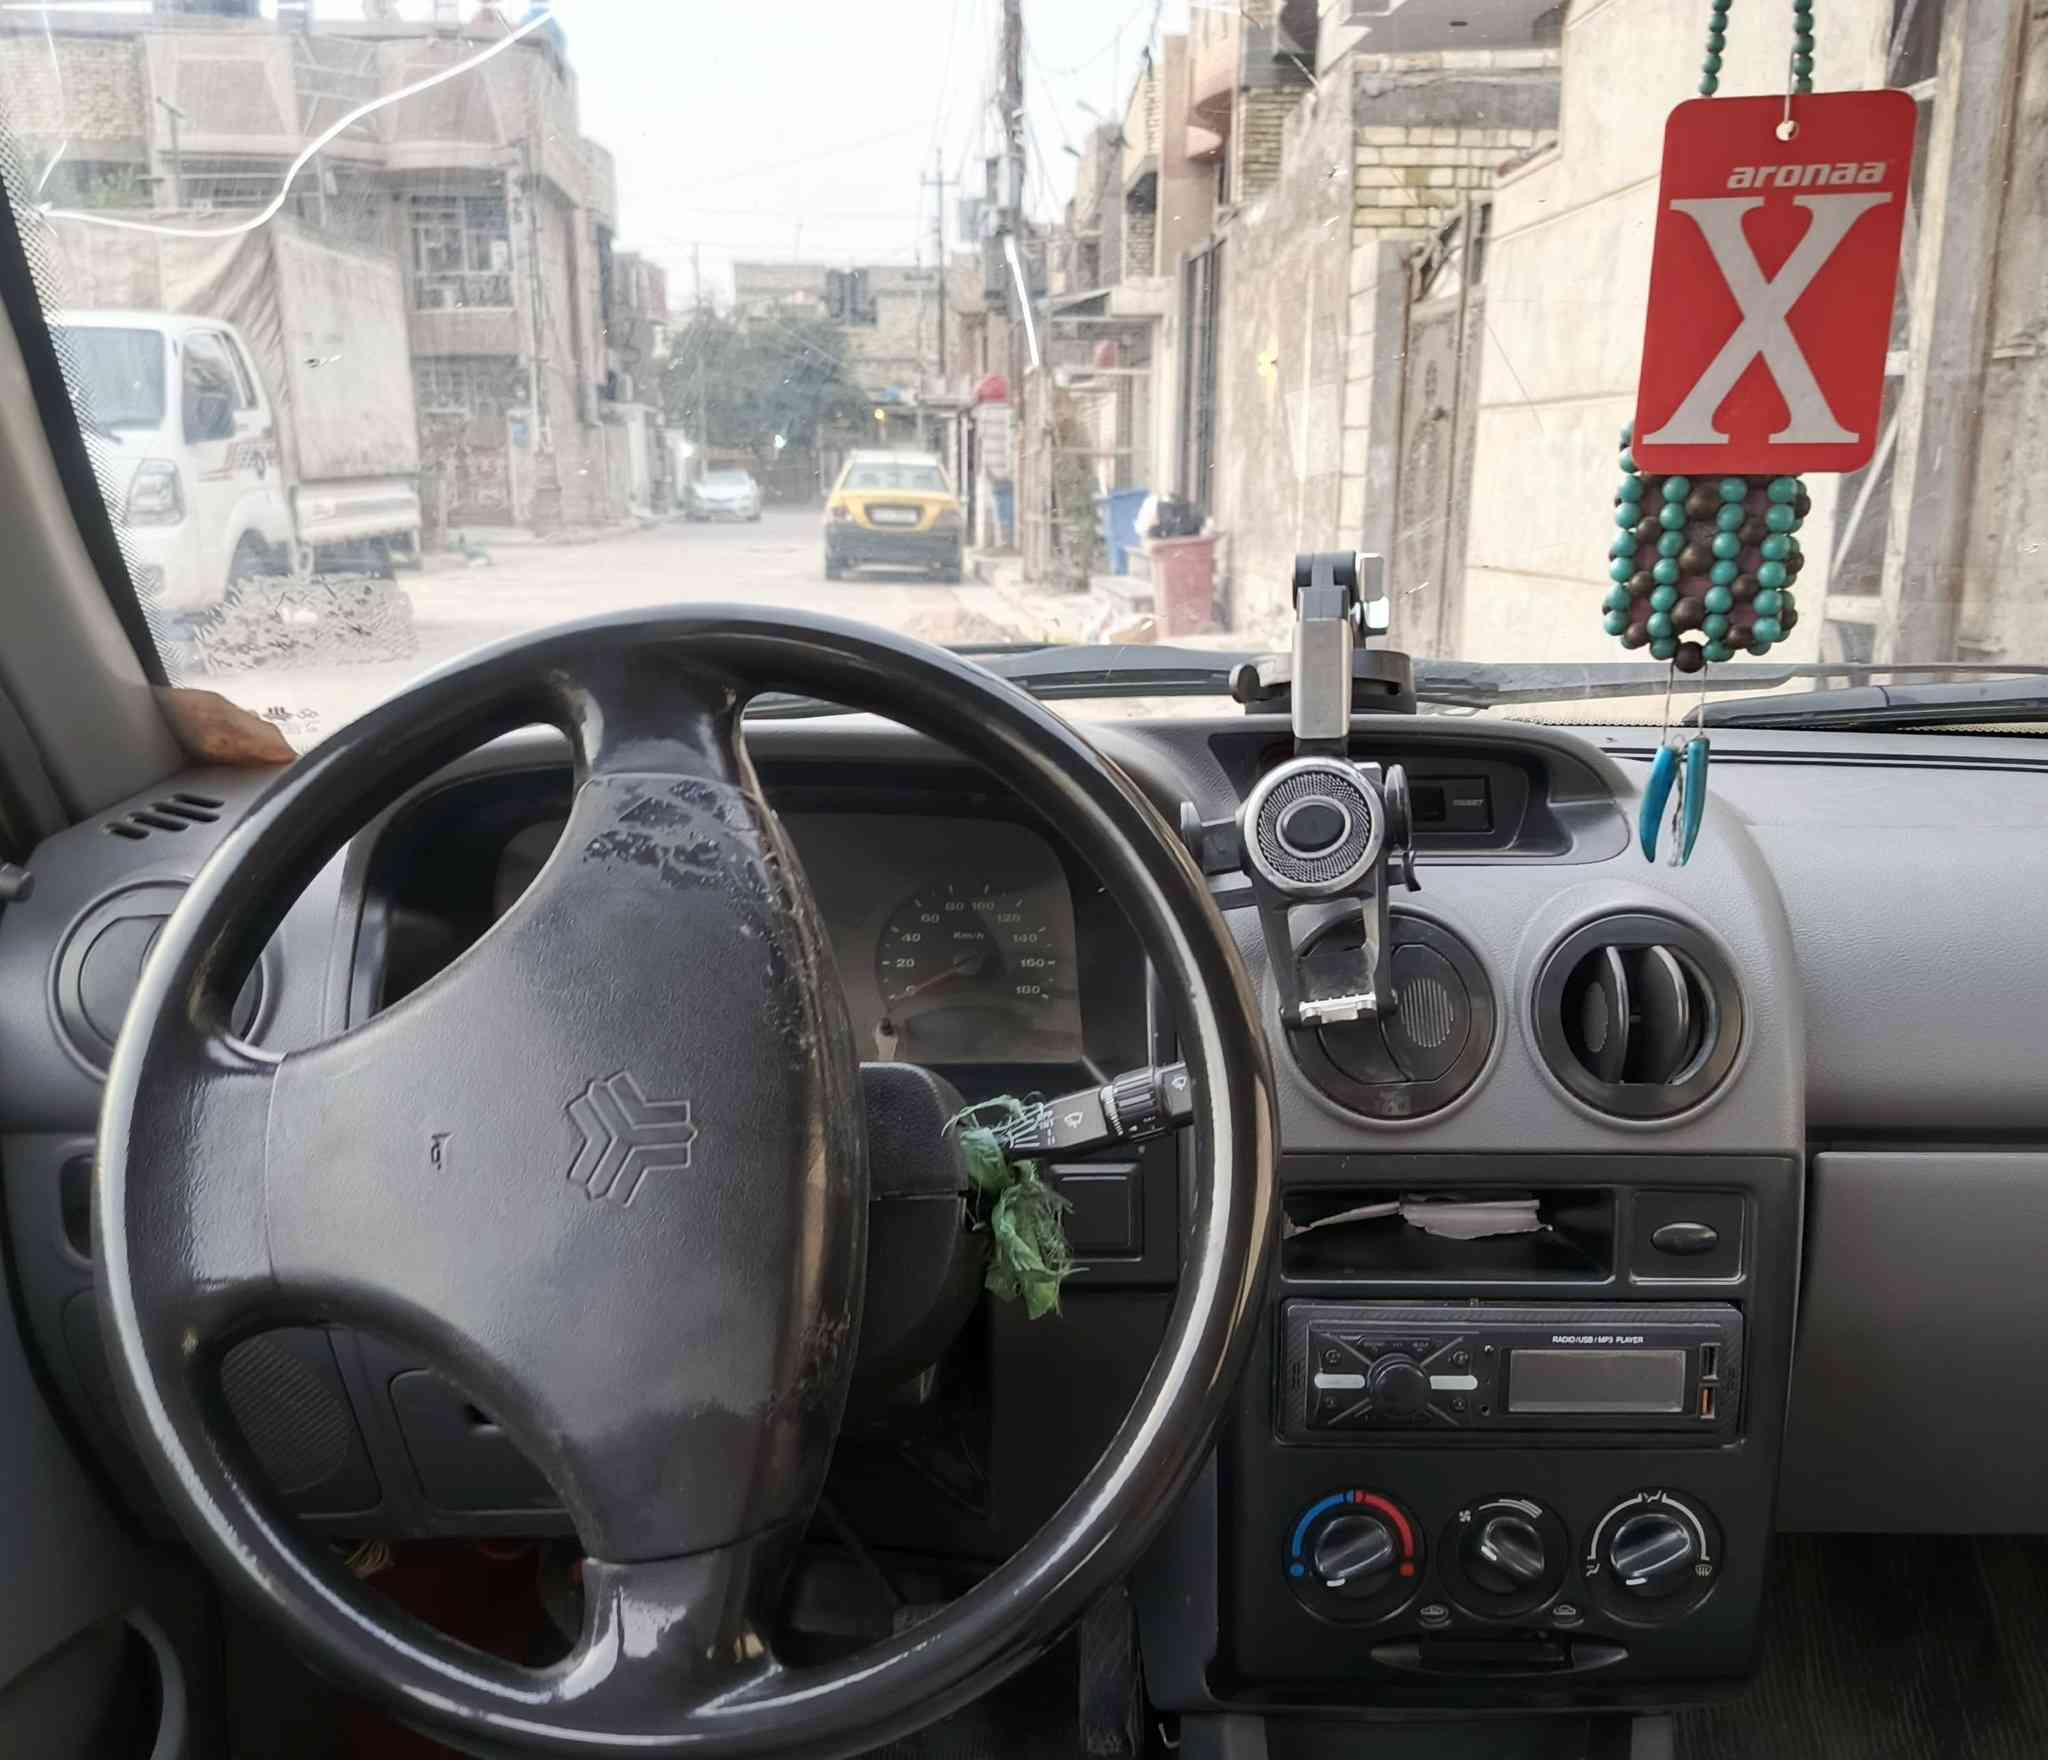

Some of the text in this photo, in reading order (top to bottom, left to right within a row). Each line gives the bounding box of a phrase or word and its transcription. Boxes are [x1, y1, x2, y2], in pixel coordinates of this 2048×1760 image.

[1727, 162, 1887, 189] aronaa
[1642, 192, 1893, 444] X
[945, 901, 964, 911] 80
[971, 901, 995, 911] 100
[920, 913, 940, 923] 60
[901, 933, 921, 942] 40
[896, 958, 915, 968] 20
[1615, 1336, 1644, 1344] PLAYER
